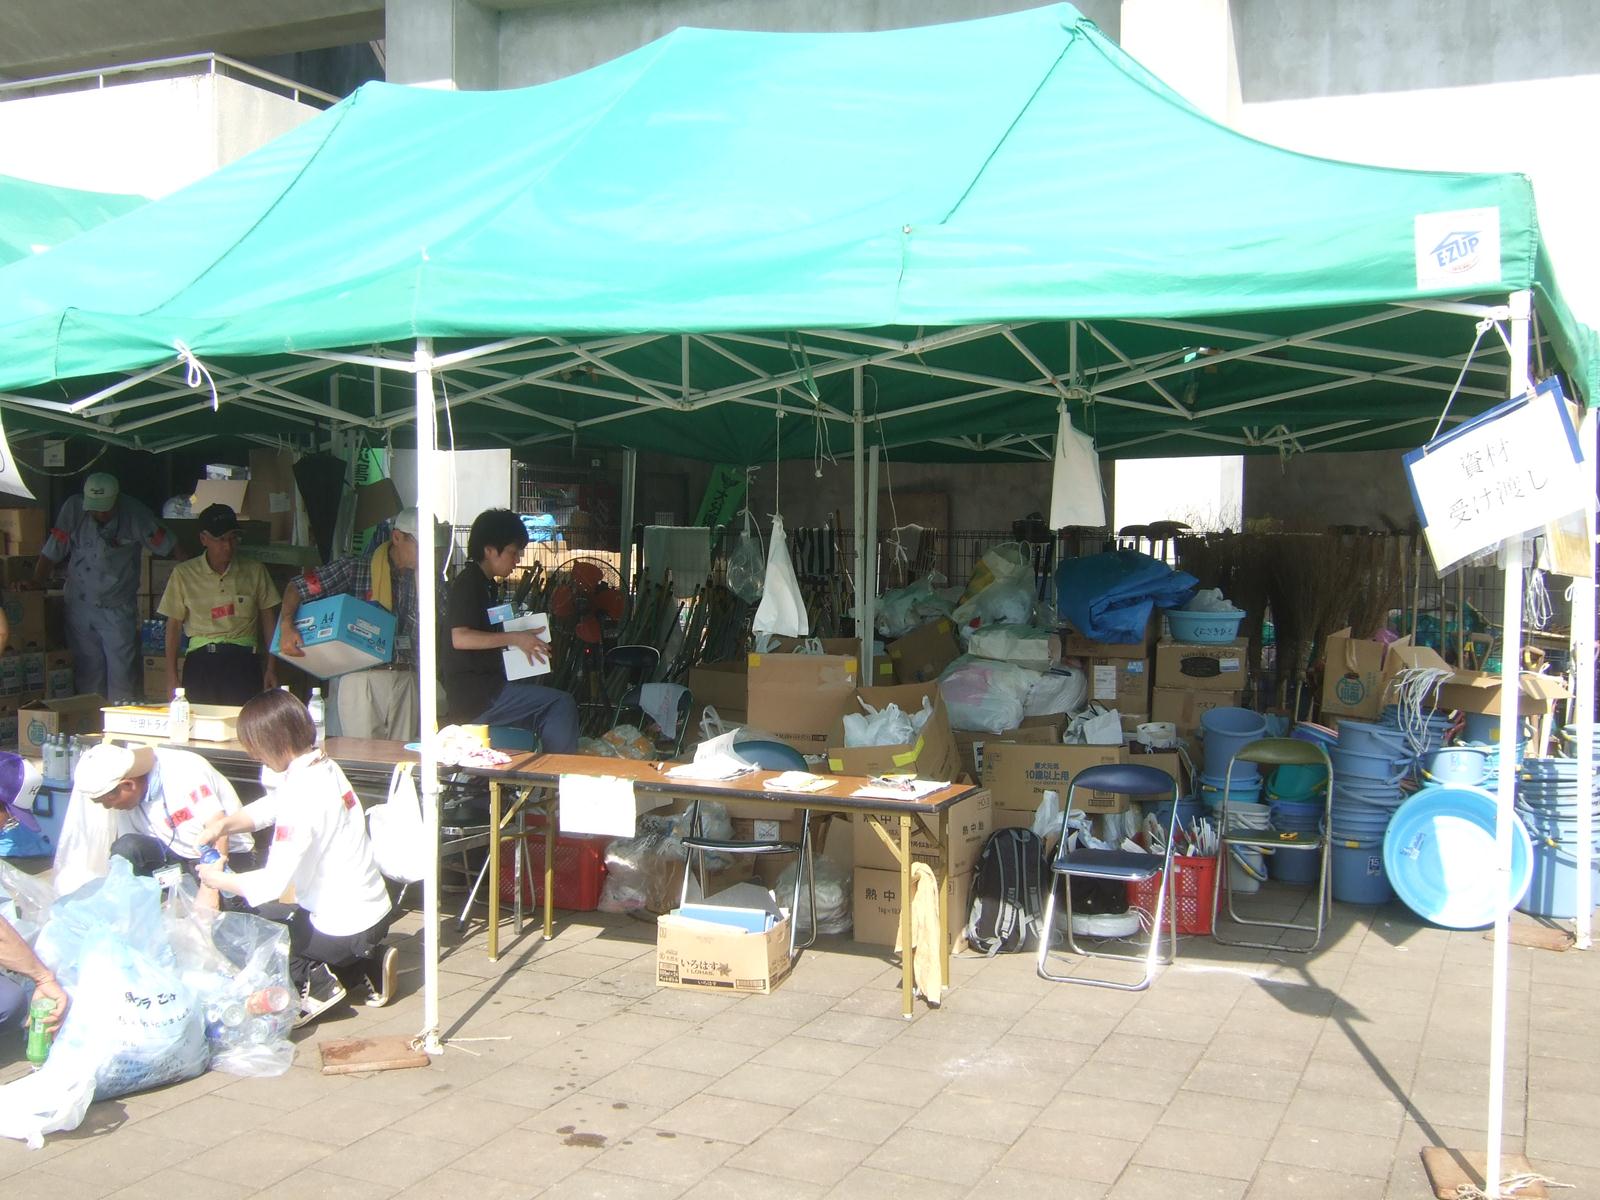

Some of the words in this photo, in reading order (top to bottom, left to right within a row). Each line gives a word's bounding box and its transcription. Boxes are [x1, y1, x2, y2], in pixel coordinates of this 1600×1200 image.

[1460, 439, 1508, 480] 資材
[321, 611, 335, 625] A4
[680, 959, 719, 971] いろはす
